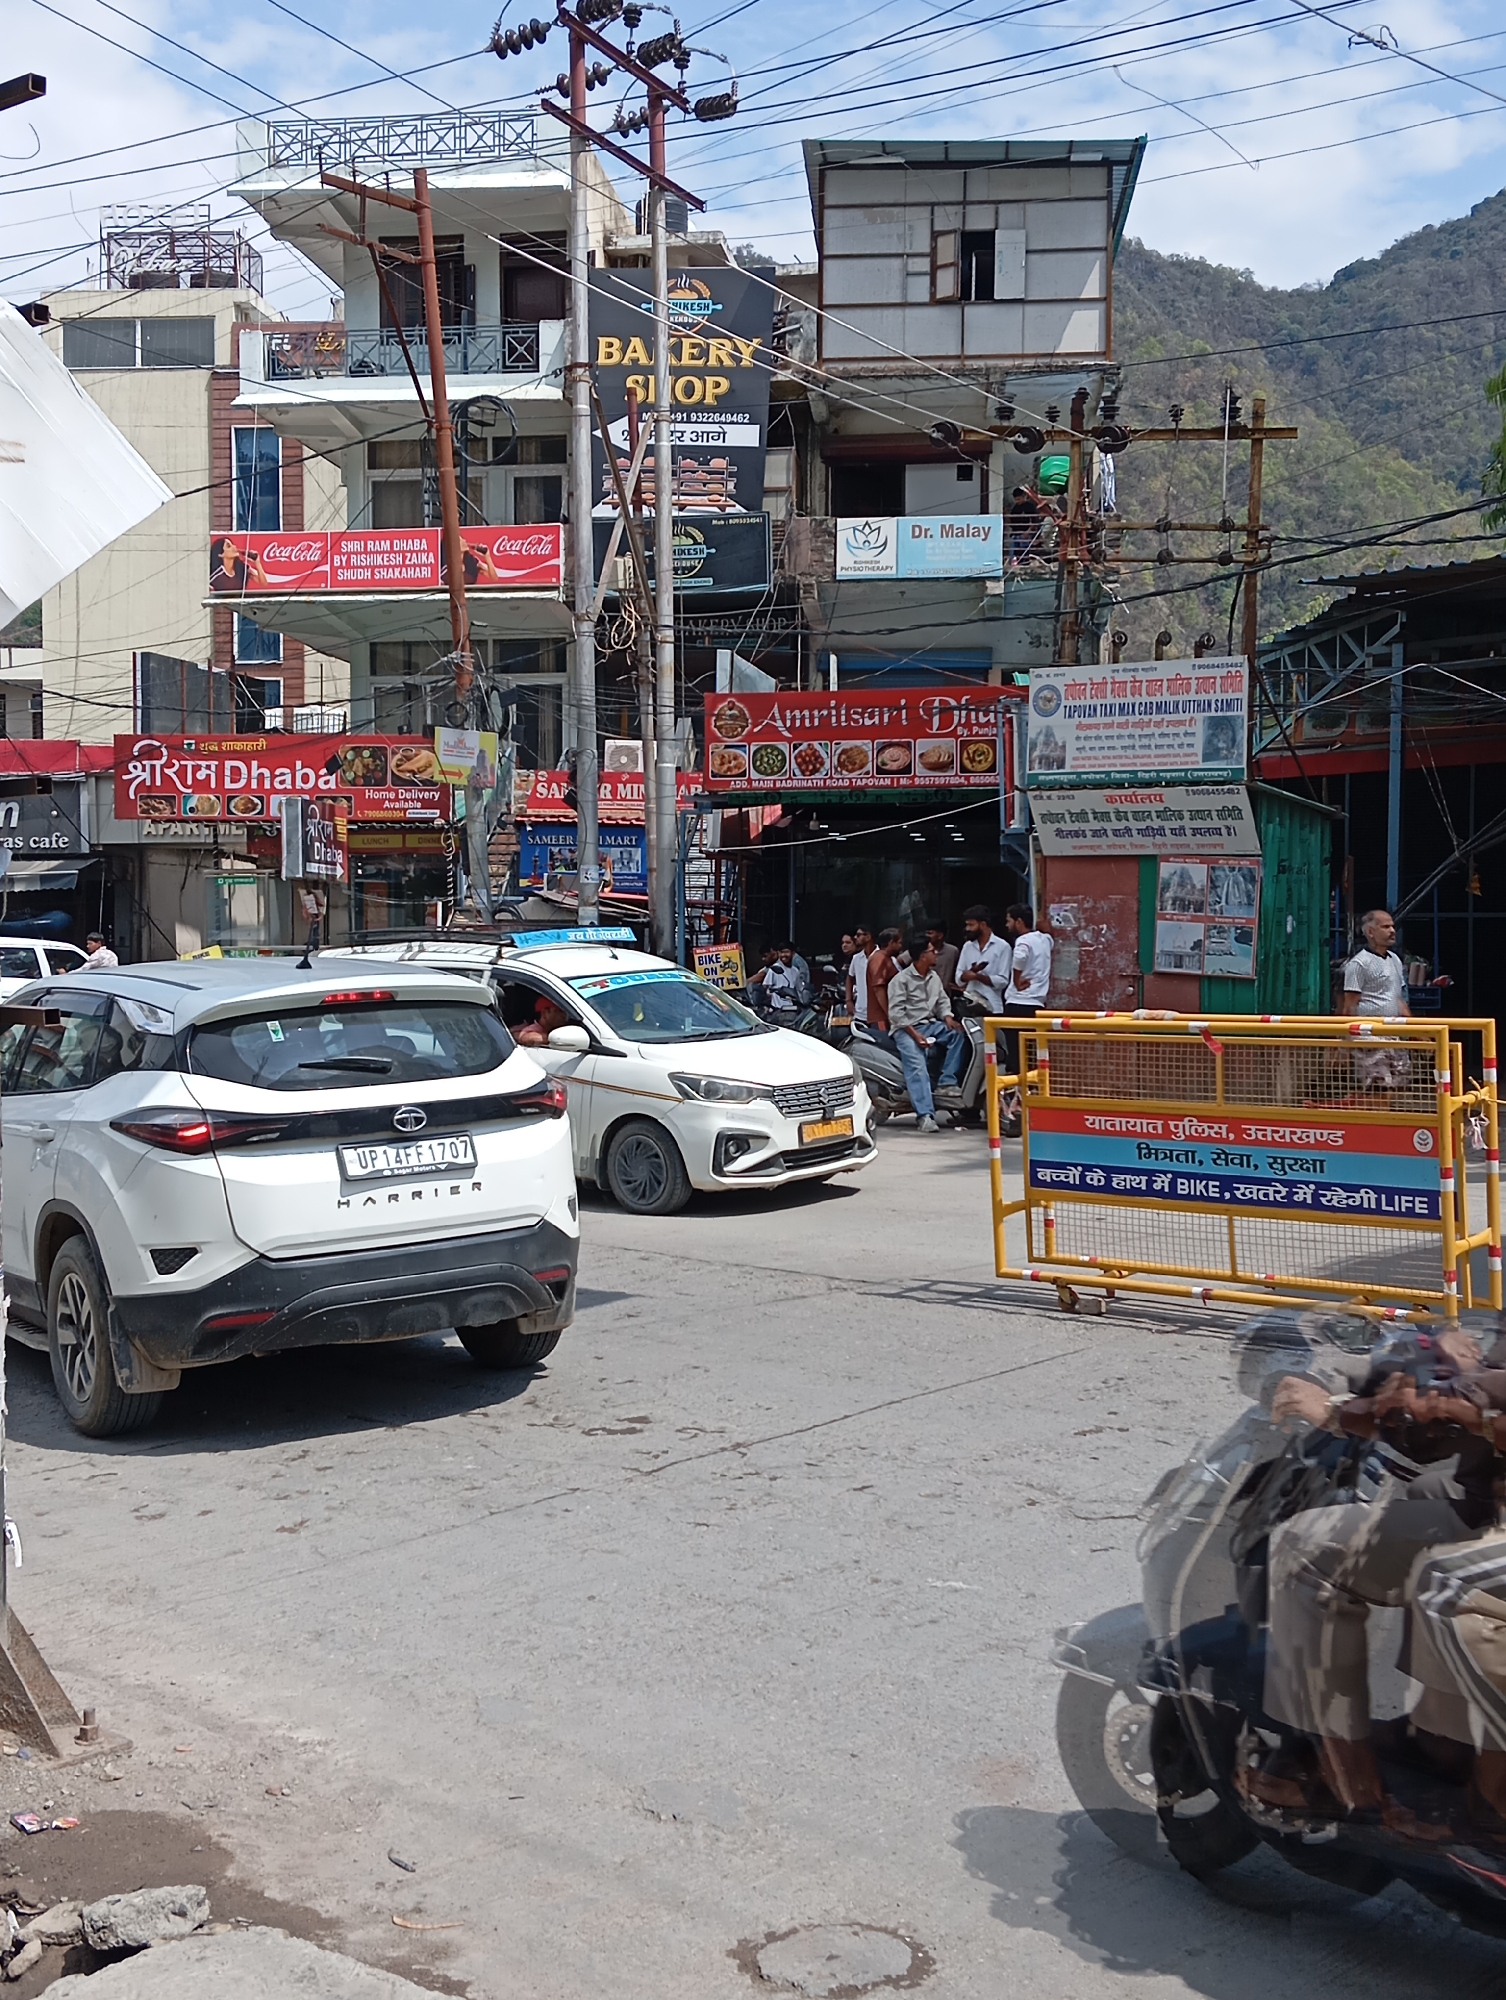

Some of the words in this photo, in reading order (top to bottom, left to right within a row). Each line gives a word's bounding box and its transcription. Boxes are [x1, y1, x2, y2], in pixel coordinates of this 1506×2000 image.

[690, 425, 727, 443] आगे
[911, 524, 934, 539] Dr.
[940, 523, 992, 541] Malay
[262, 541, 325, 563] Coca-Cola
[341, 540, 364, 552] SHRI
[367, 540, 390, 552] RAM
[394, 538, 427, 551] DHABA
[493, 533, 556, 557] Coca-Cola
[333, 555, 347, 567] BY
[351, 553, 403, 566] RISHIKESH
[405, 551, 435, 565] ZAIKA
[337, 568, 371, 580] SHUDH
[375, 566, 431, 579] SHAKAHARI
[1064, 678, 1087, 700] तपोवन
[1145, 679, 1164, 697] वाहन
[1166, 672, 1192, 696] मालिक
[1219, 669, 1244, 694] समिति
[1064, 703, 1098, 719] TAPOVAN
[1100, 703, 1117, 718] TAXI
[1118, 701, 1137, 717] MAX
[1138, 701, 1154, 716] CAB
[1155, 700, 1181, 715] MALIK
[1182, 698, 1212, 714] UTTHAN
[1214, 697, 1243, 713] SAMITI
[753, 699, 908, 738] Amritsari
[957, 727, 970, 738] By.
[221, 738, 268, 751] शाकाहारी
[121, 739, 219, 800] श्रीराम
[224, 760, 337, 790] Dhaba
[752, 780, 774, 788] MAIN
[776, 779, 824, 788] BADRINATH
[826, 779, 849, 787] ROAD
[852, 778, 891, 786] TAPOVAN
[365, 789, 396, 800] Home
[398, 789, 441, 802] Delivery
[383, 800, 422, 809] Available
[1103, 791, 1165, 804] कार्यालय
[1039, 810, 1067, 824] तपोवन
[1130, 810, 1154, 822] वाहन
[1155, 806, 1185, 822] मालिक
[1215, 805, 1244, 821] समिति
[305, 804, 334, 846] श्रीराम
[1054, 827, 1087, 839] नीलकंठ
[1089, 826, 1109, 839] जाने
[1110, 825, 1134, 838] वाली
[29, 832, 70, 849] cafe
[527, 835, 574, 845] SAMEER
[604, 836, 638, 846] MART
[314, 841, 343, 863] Dhaba
[698, 953, 722, 966] BIKE
[703, 967, 718, 976] ON
[1084, 1115, 1164, 1135] यातायात
[1168, 1116, 1236, 1141] पुलिस,
[1241, 1124, 1346, 1147] उत्तराखण्ड
[357, 1140, 468, 1170] UP14FF1707
[1135, 1142, 1204, 1167] मित्रता,
[1210, 1147, 1260, 1171] सेवा,
[1265, 1154, 1327, 1177] सुरक्षा
[337, 1181, 482, 1209] HARRIER
[1036, 1165, 1083, 1185] बच्चों
[1085, 1168, 1106, 1187] के
[1111, 1173, 1148, 1190] हाथ
[1152, 1173, 1173, 1192] में
[1292, 1183, 1317, 1205] में
[1318, 1186, 1378, 1209] रहेगी
[1381, 1193, 1429, 1214] LIFE
